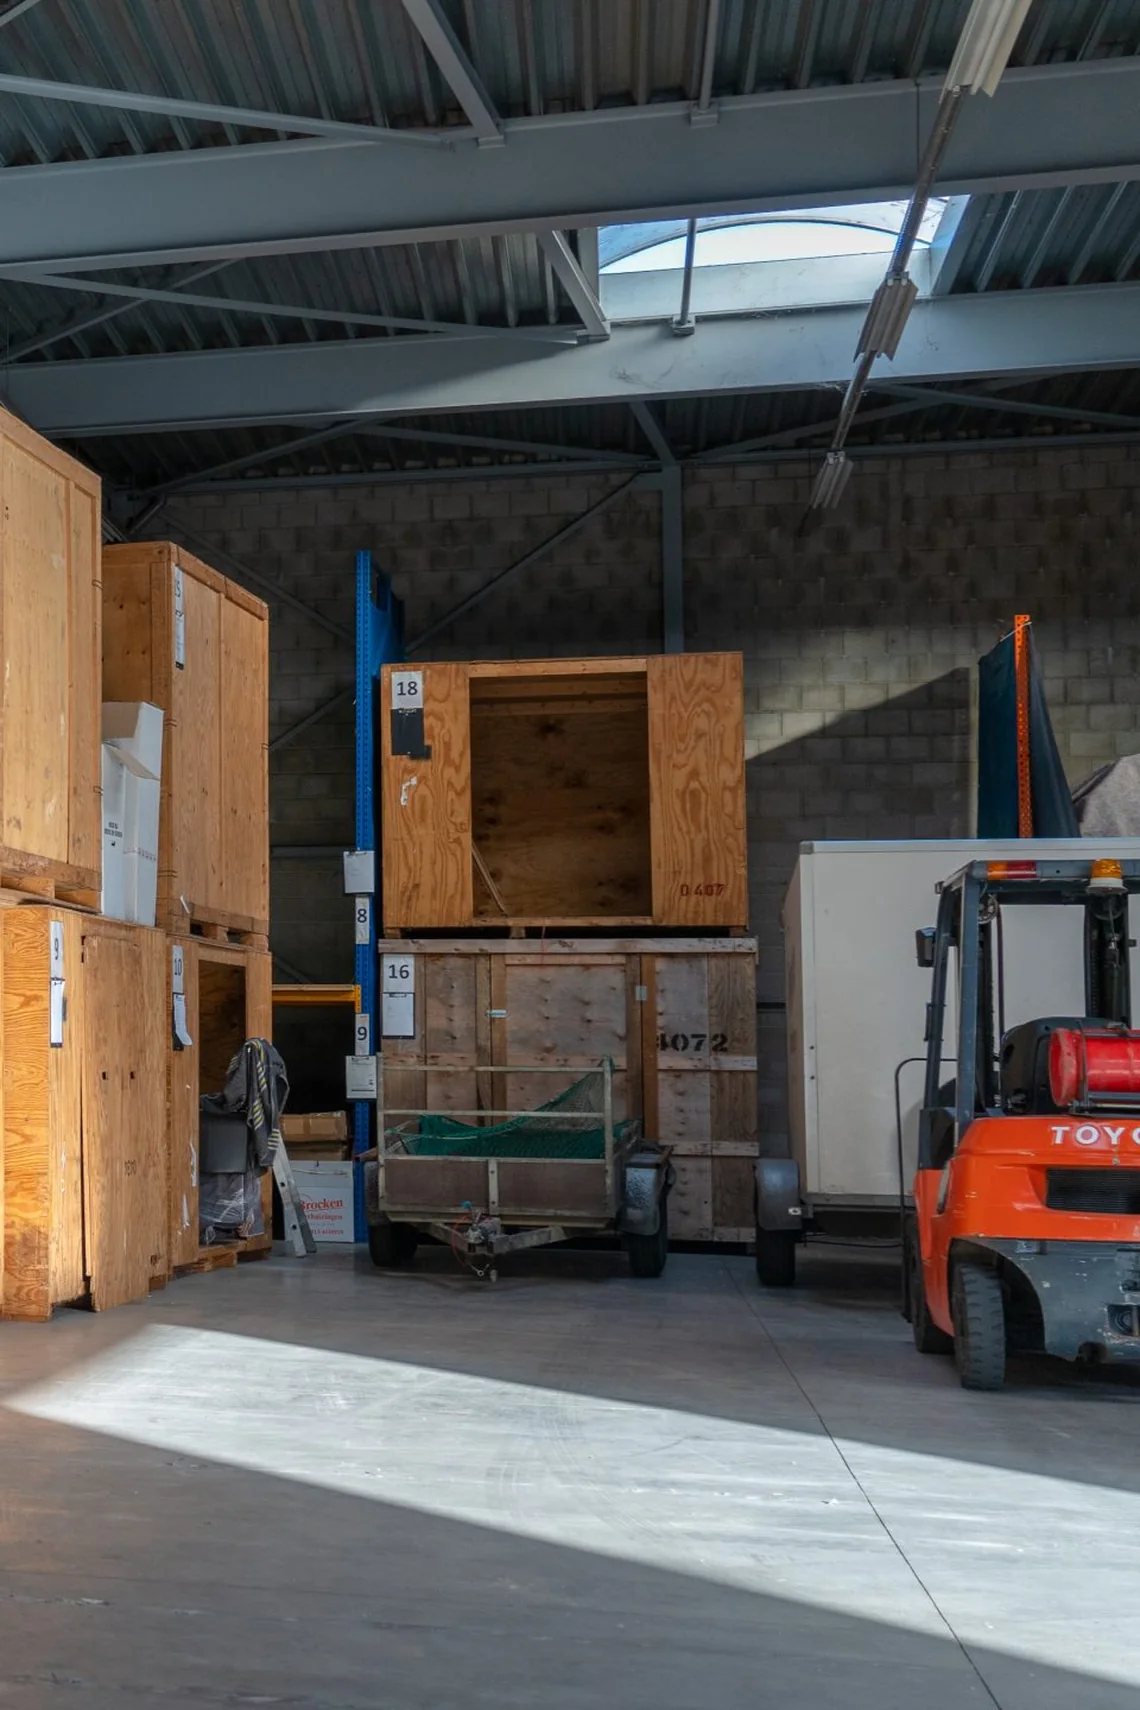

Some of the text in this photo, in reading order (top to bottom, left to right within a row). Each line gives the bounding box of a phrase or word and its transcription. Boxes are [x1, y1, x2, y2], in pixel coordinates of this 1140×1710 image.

[396, 681, 418, 696] 18
[357, 908, 368, 923] 8
[54, 938, 60, 960] 9
[174, 958, 183, 976] 10
[388, 964, 410, 979] 16
[357, 1026, 368, 1041] 9
